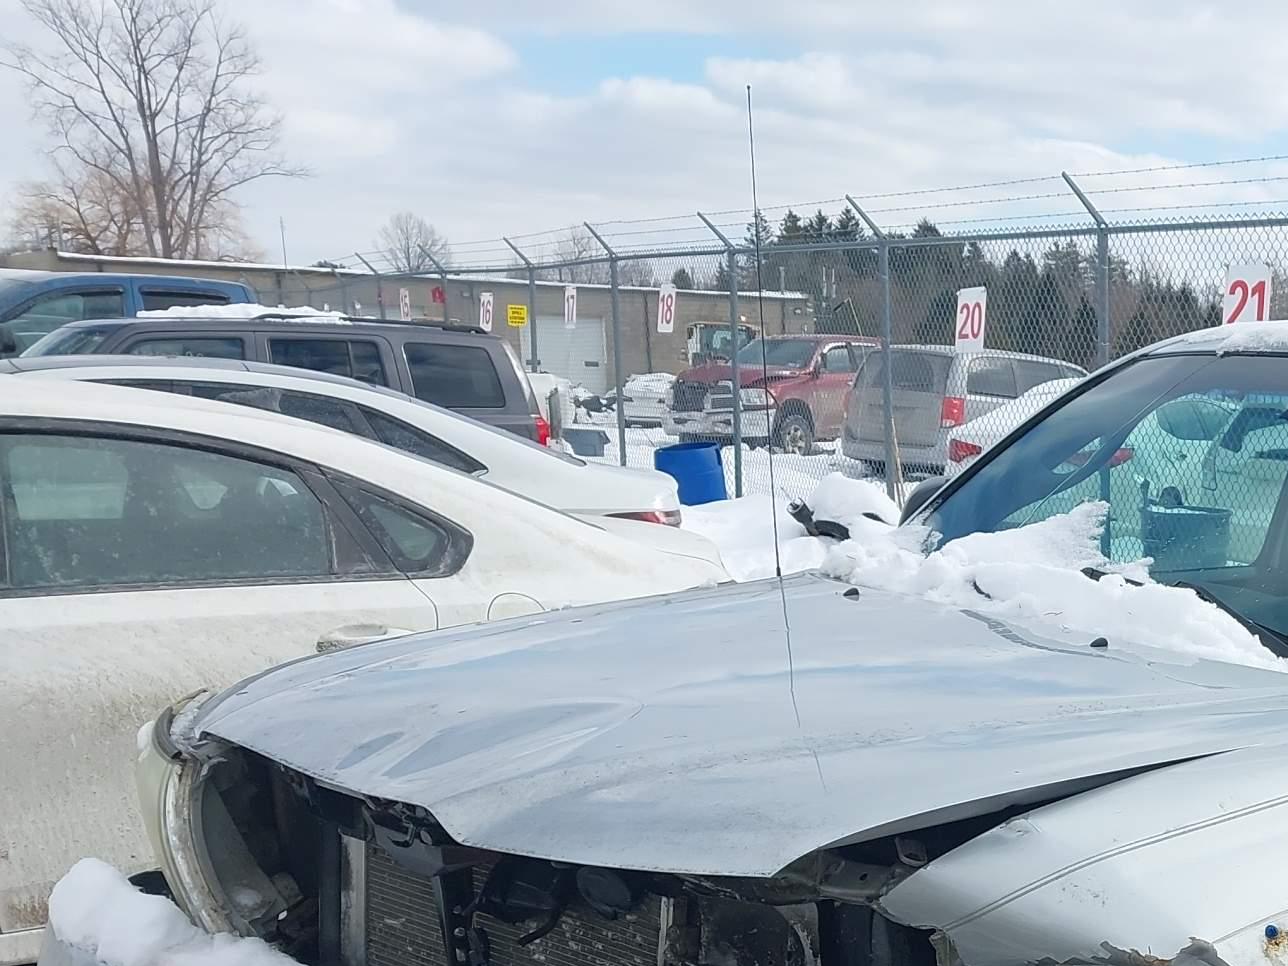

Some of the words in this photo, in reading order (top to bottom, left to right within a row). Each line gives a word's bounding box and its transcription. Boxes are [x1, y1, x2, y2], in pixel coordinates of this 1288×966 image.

[401, 295, 409, 317] 15
[482, 299, 491, 325] 16
[566, 294, 575, 321] 17
[660, 293, 673, 325] 18
[1226, 279, 1266, 324] 21
[958, 302, 982, 340] 20
